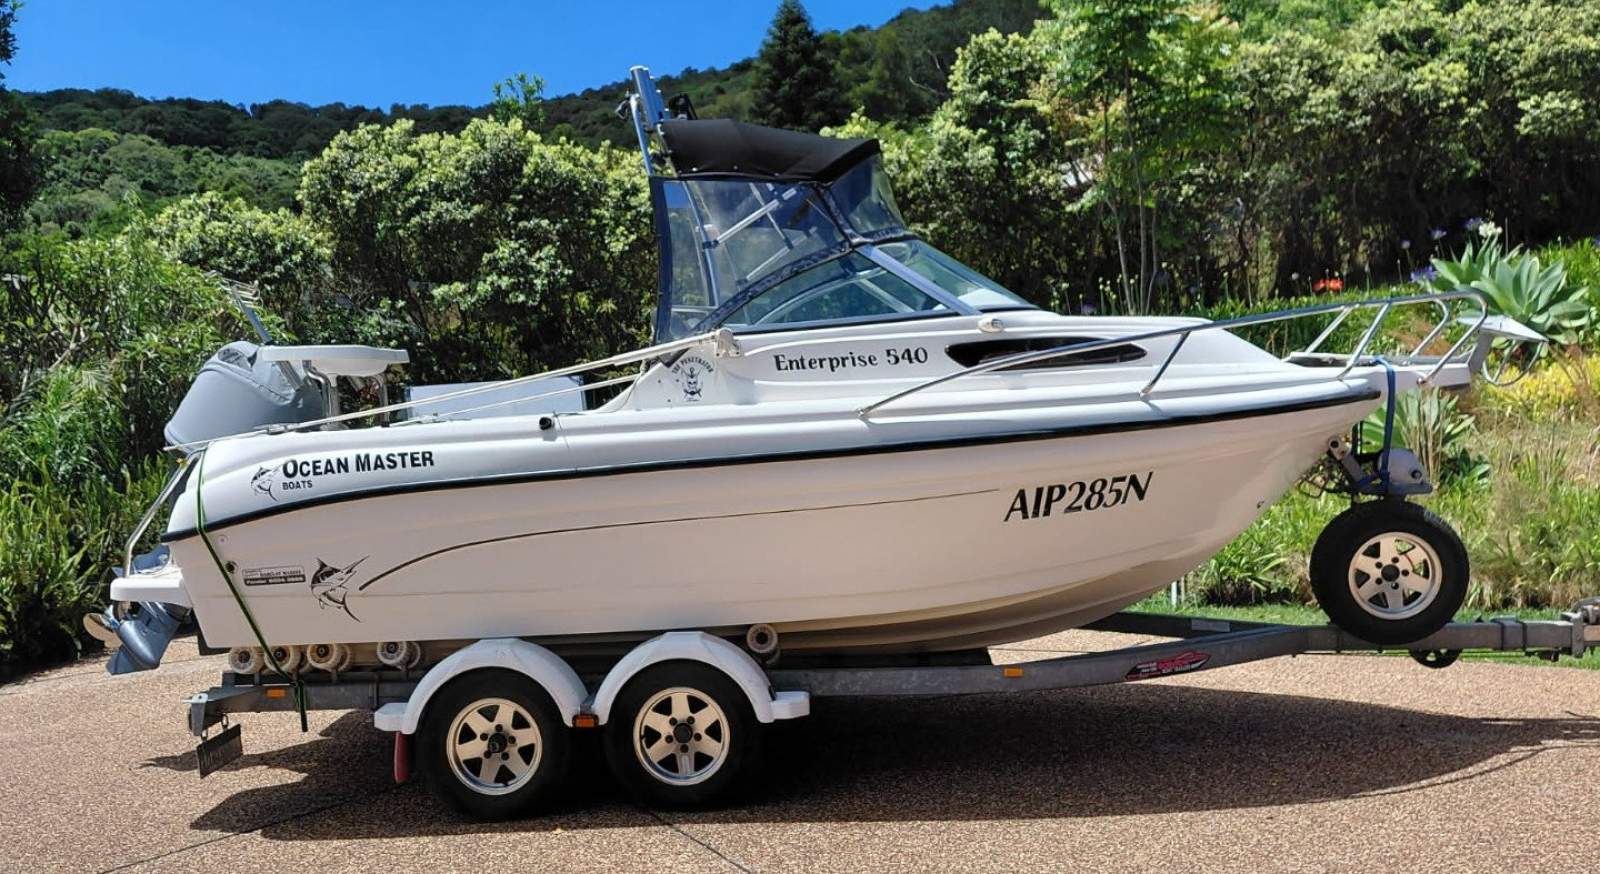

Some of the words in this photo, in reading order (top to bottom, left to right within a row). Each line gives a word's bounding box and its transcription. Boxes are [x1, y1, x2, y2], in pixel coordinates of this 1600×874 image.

[773, 351, 878, 372] Enterprise
[885, 347, 928, 366] 540
[282, 457, 349, 478] OCEAN
[355, 450, 435, 472] MASTER
[282, 479, 313, 491] BOATS
[1003, 471, 1154, 522] AIP285N
